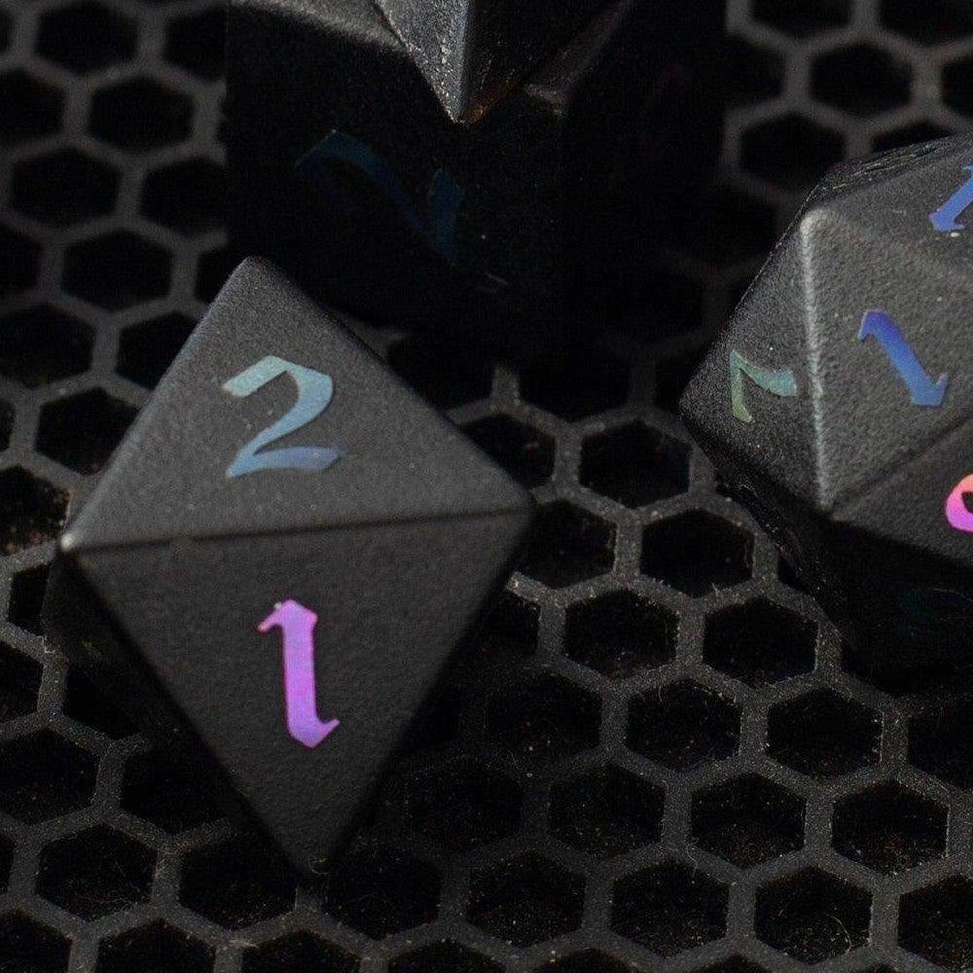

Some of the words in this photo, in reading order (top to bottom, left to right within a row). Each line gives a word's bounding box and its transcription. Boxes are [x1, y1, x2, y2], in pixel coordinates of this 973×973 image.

[222, 355, 338, 479] 2
[857, 309, 950, 408] 1
[256, 599, 340, 749] 1
